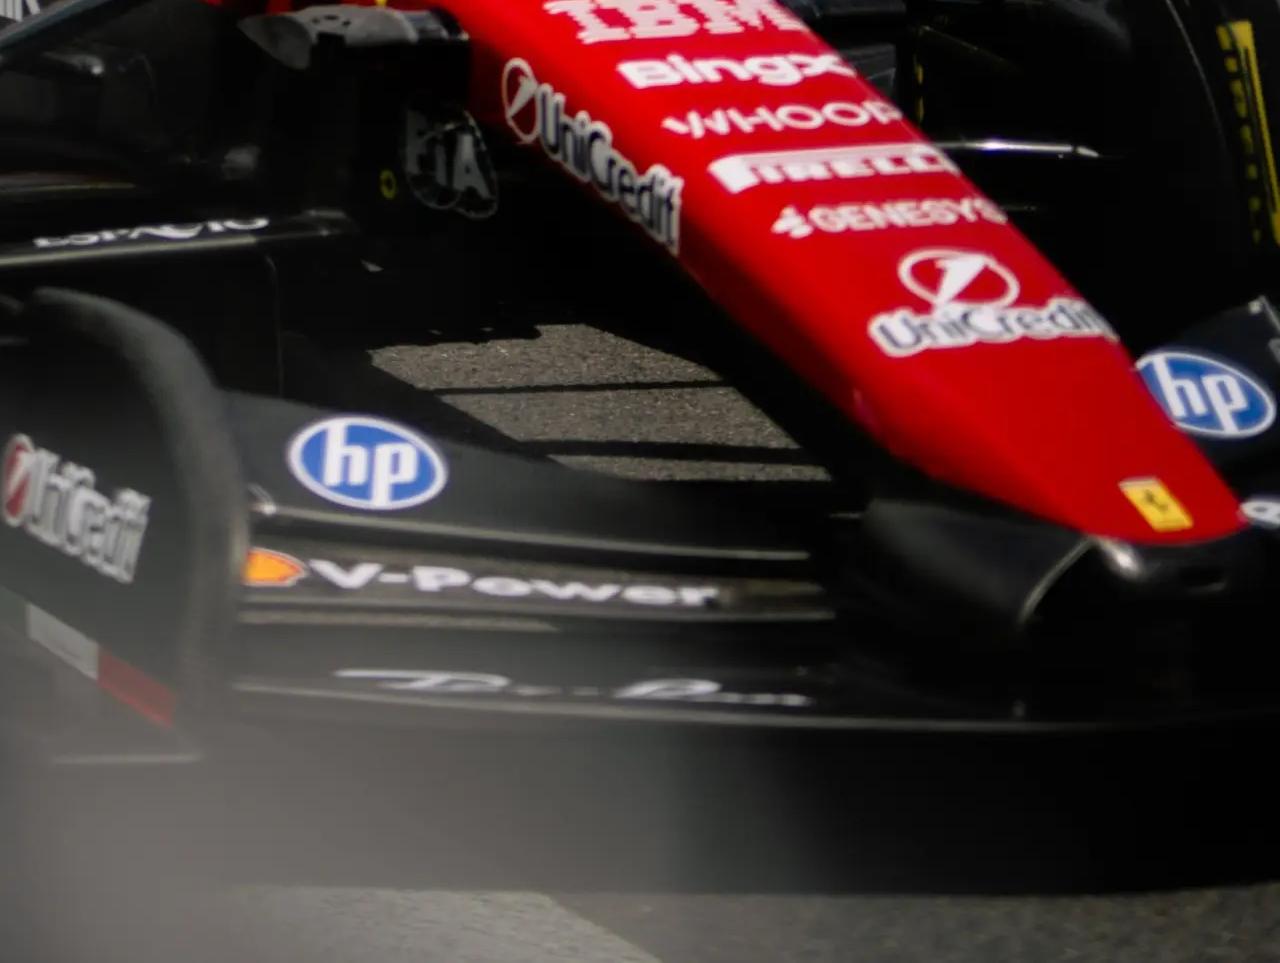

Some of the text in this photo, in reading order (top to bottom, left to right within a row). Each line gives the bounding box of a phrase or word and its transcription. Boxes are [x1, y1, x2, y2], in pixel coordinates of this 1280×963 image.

[661, 99, 904, 139] WHOOP
[1153, 354, 1249, 434] hp
[324, 420, 420, 508] hp
[308, 558, 719, 606] V-Power
